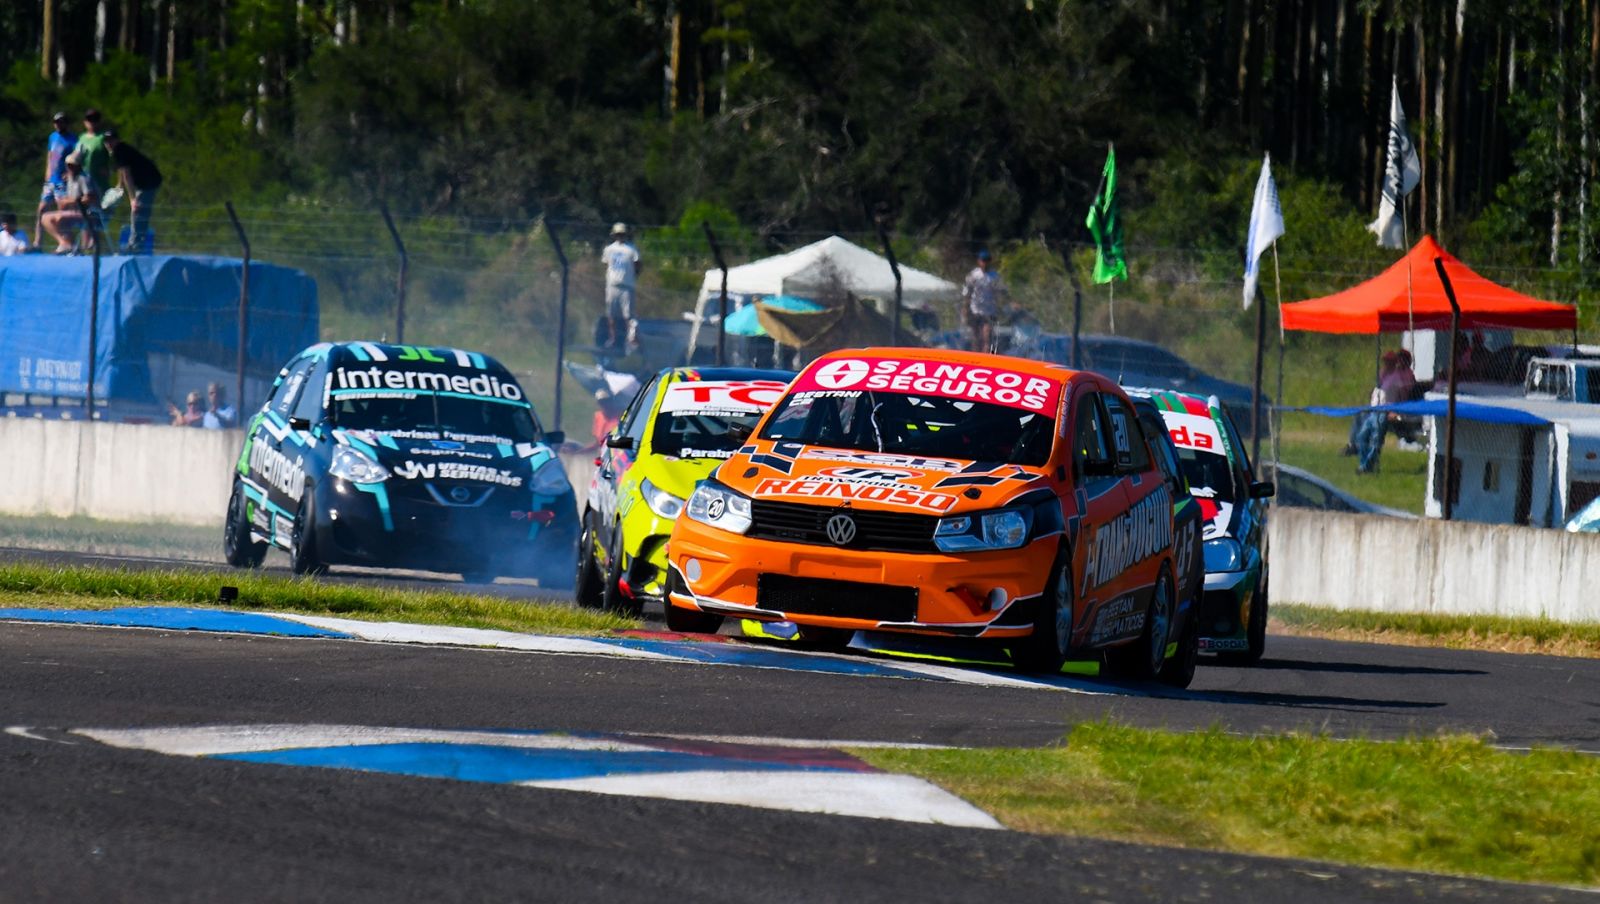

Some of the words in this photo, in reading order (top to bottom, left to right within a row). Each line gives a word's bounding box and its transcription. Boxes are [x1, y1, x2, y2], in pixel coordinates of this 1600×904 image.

[337, 366, 522, 401] intermedio
[866, 374, 1046, 410] SEGUROS
[873, 360, 1051, 397] SANCOR
[680, 447, 736, 460] Parabr
[755, 479, 957, 511] REINOSO
[803, 475, 920, 491] TRANSPORTES
[708, 499, 724, 518] 20
